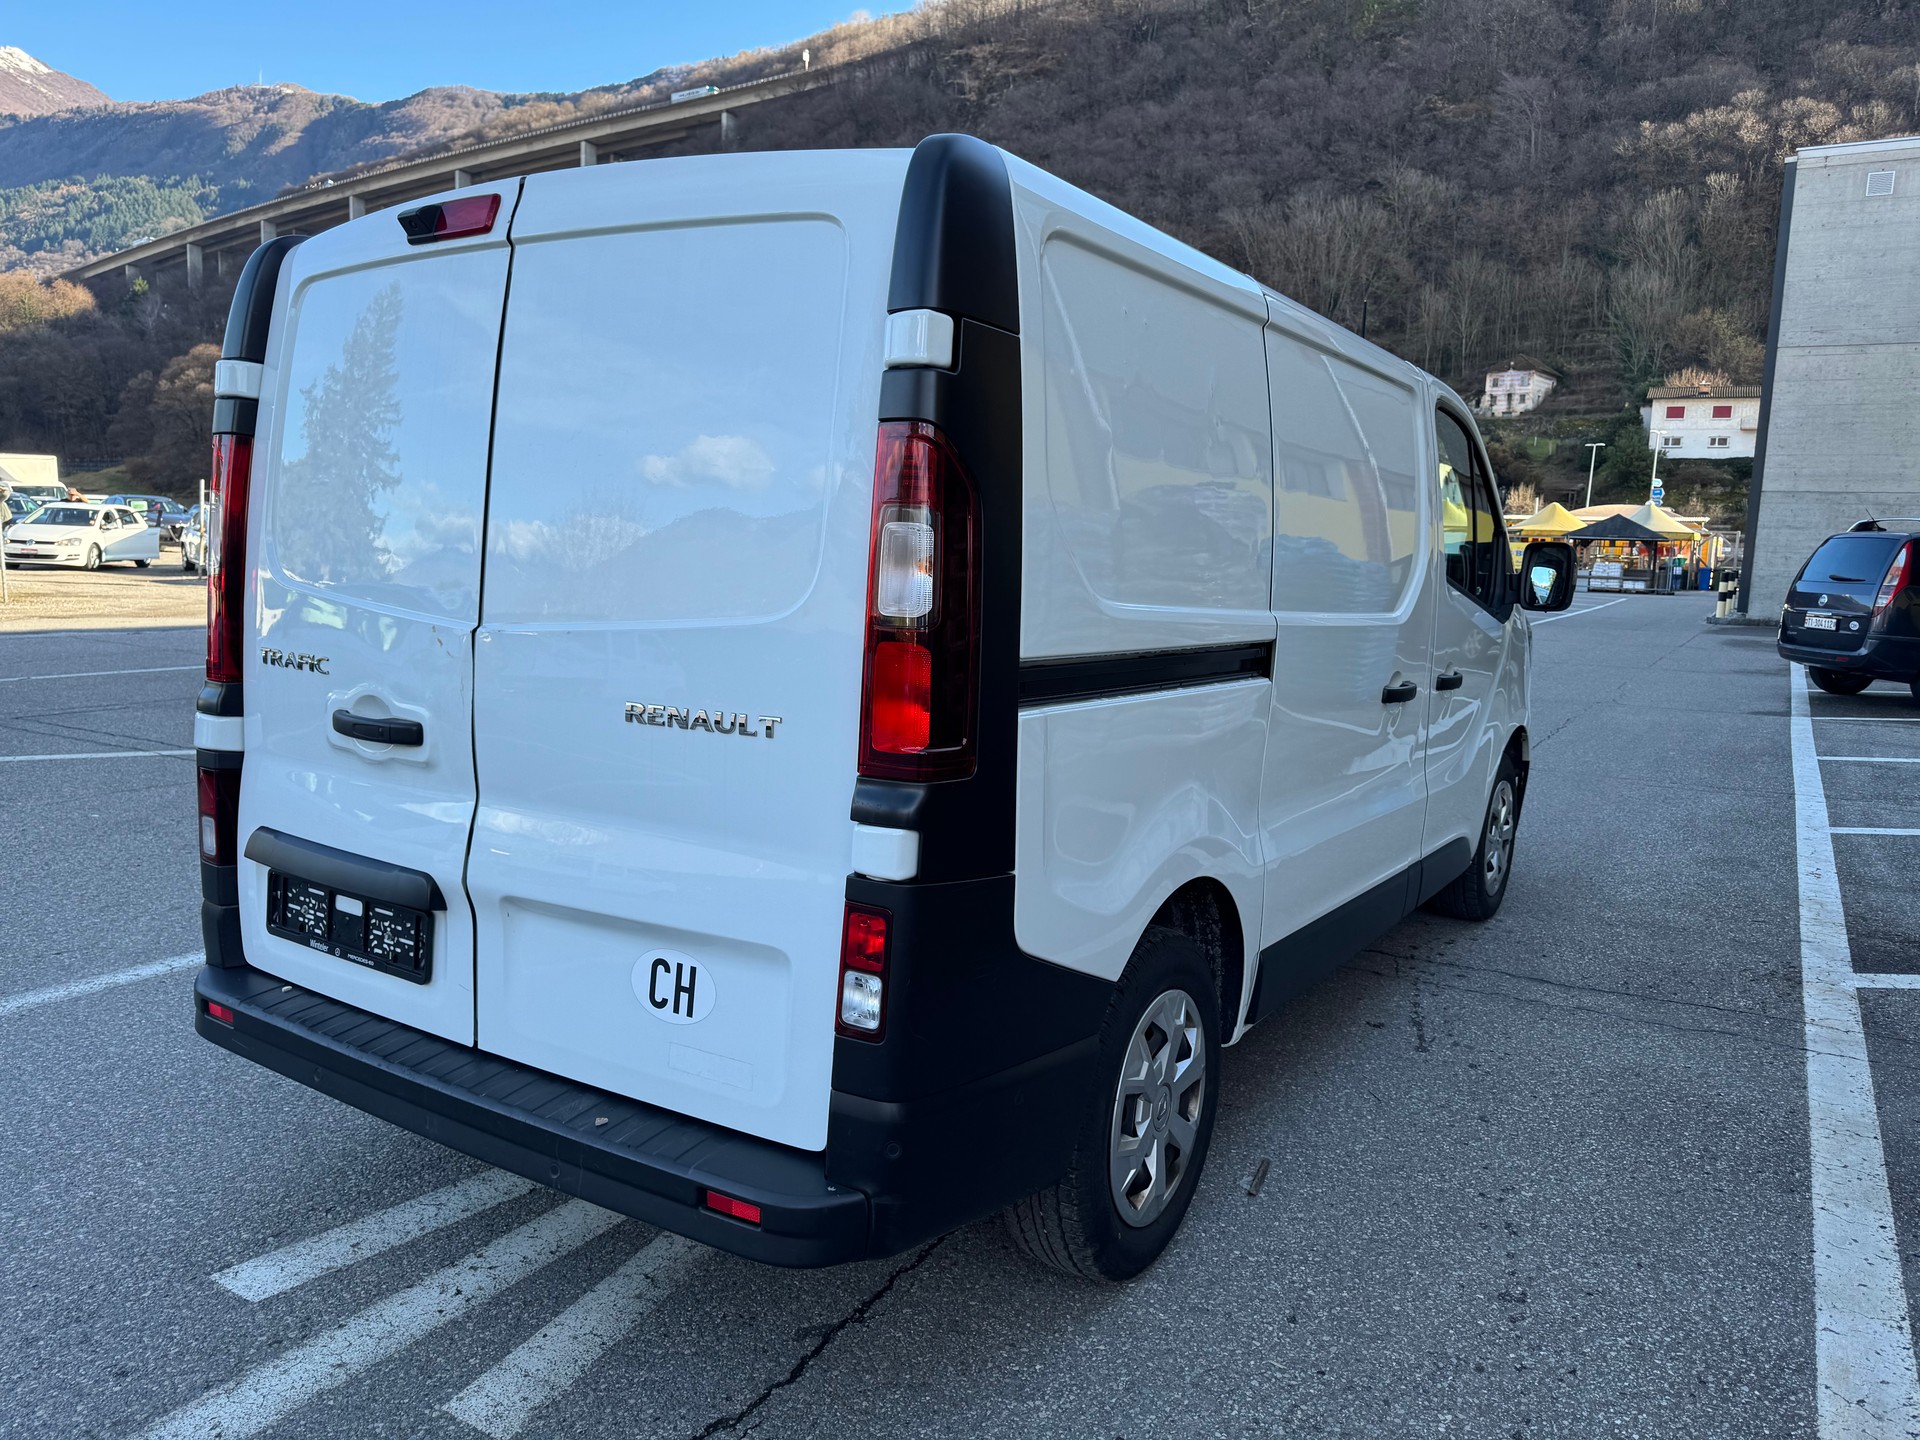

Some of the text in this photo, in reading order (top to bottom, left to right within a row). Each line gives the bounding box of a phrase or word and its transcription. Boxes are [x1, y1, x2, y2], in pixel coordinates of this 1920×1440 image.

[260, 646, 330, 676] TRAFIC
[624, 701, 783, 739] RENAULT
[648, 957, 697, 1018] CH
